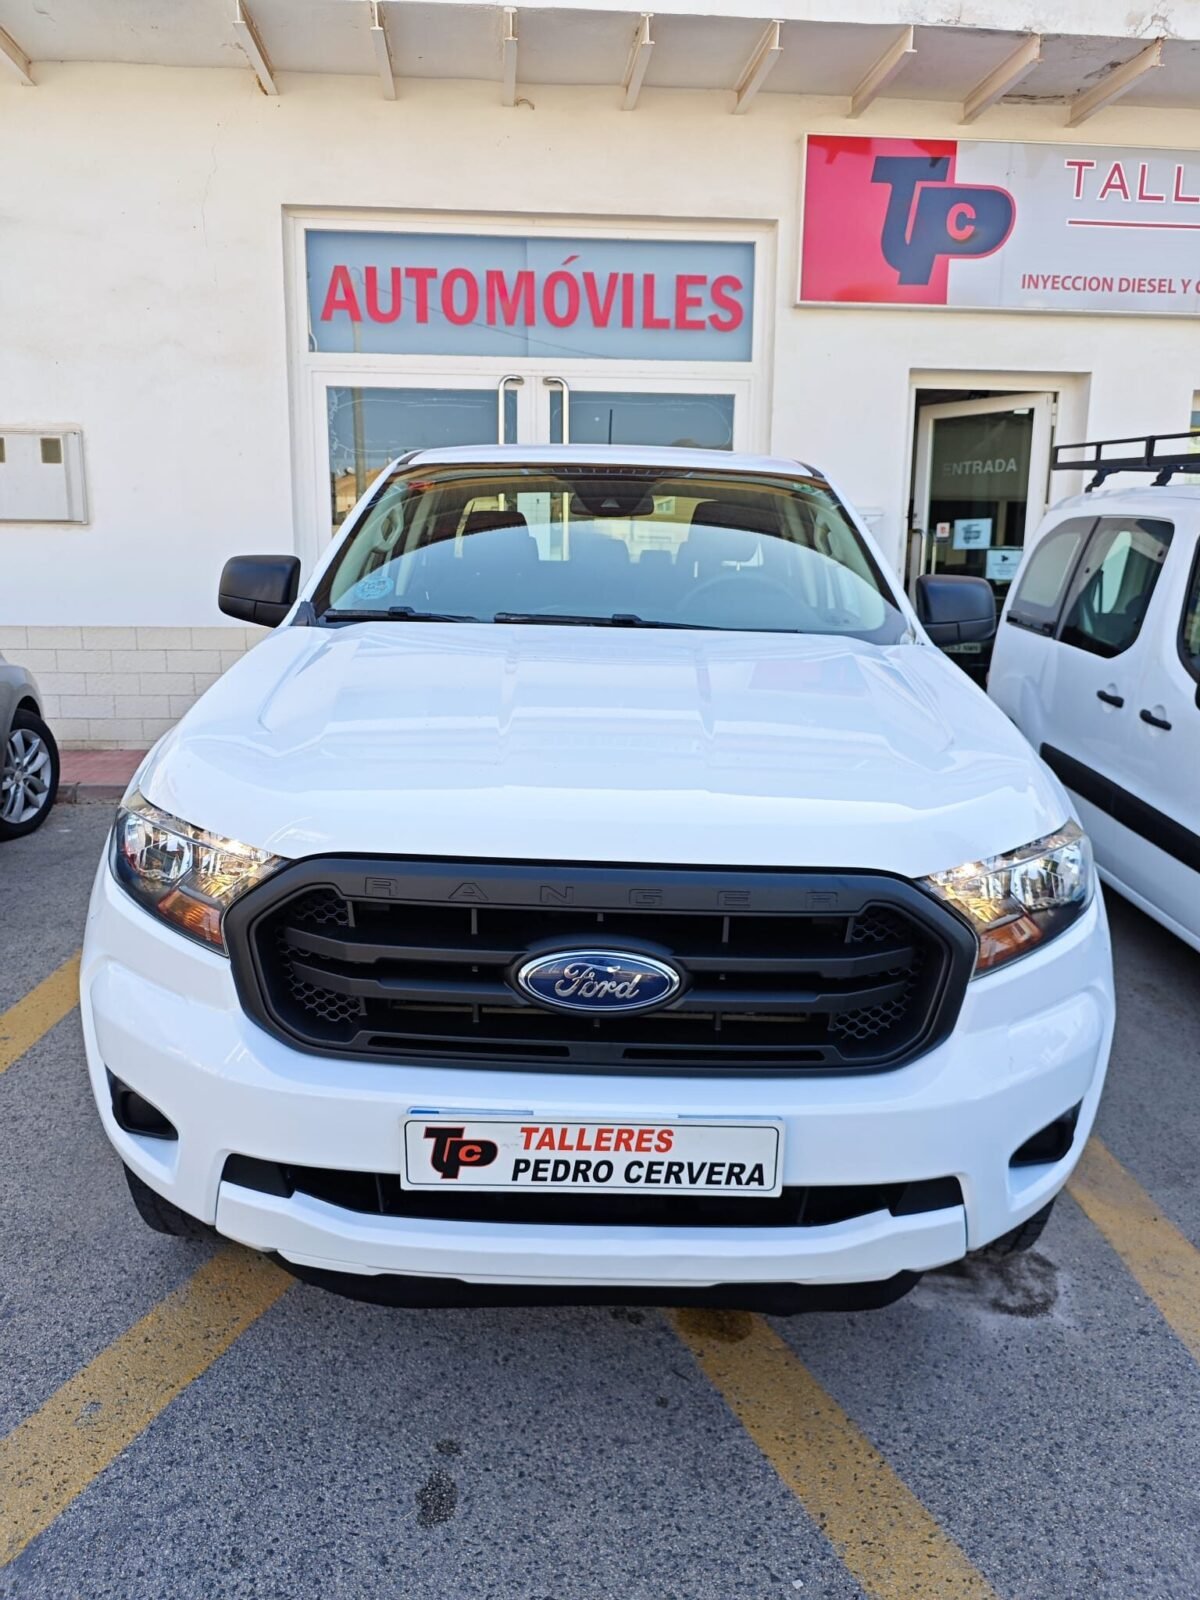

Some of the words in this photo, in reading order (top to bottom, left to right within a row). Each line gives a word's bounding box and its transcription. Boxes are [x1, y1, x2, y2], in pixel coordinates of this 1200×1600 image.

[1065, 160, 1200, 203] TALL
[320, 255, 744, 333] AUTOMÓVILES
[1021, 274, 1114, 292] INYECCION
[1118, 277, 1176, 294] DIESEL
[1181, 279, 1192, 294] Y
[943, 458, 1017, 476] ENTRADA
[364, 876, 839, 909] RANGER
[555, 962, 642, 999] Ford
[520, 1127, 675, 1153] TALLERES
[511, 1158, 614, 1184] PEDRO
[624, 1160, 765, 1186] CERVERA
